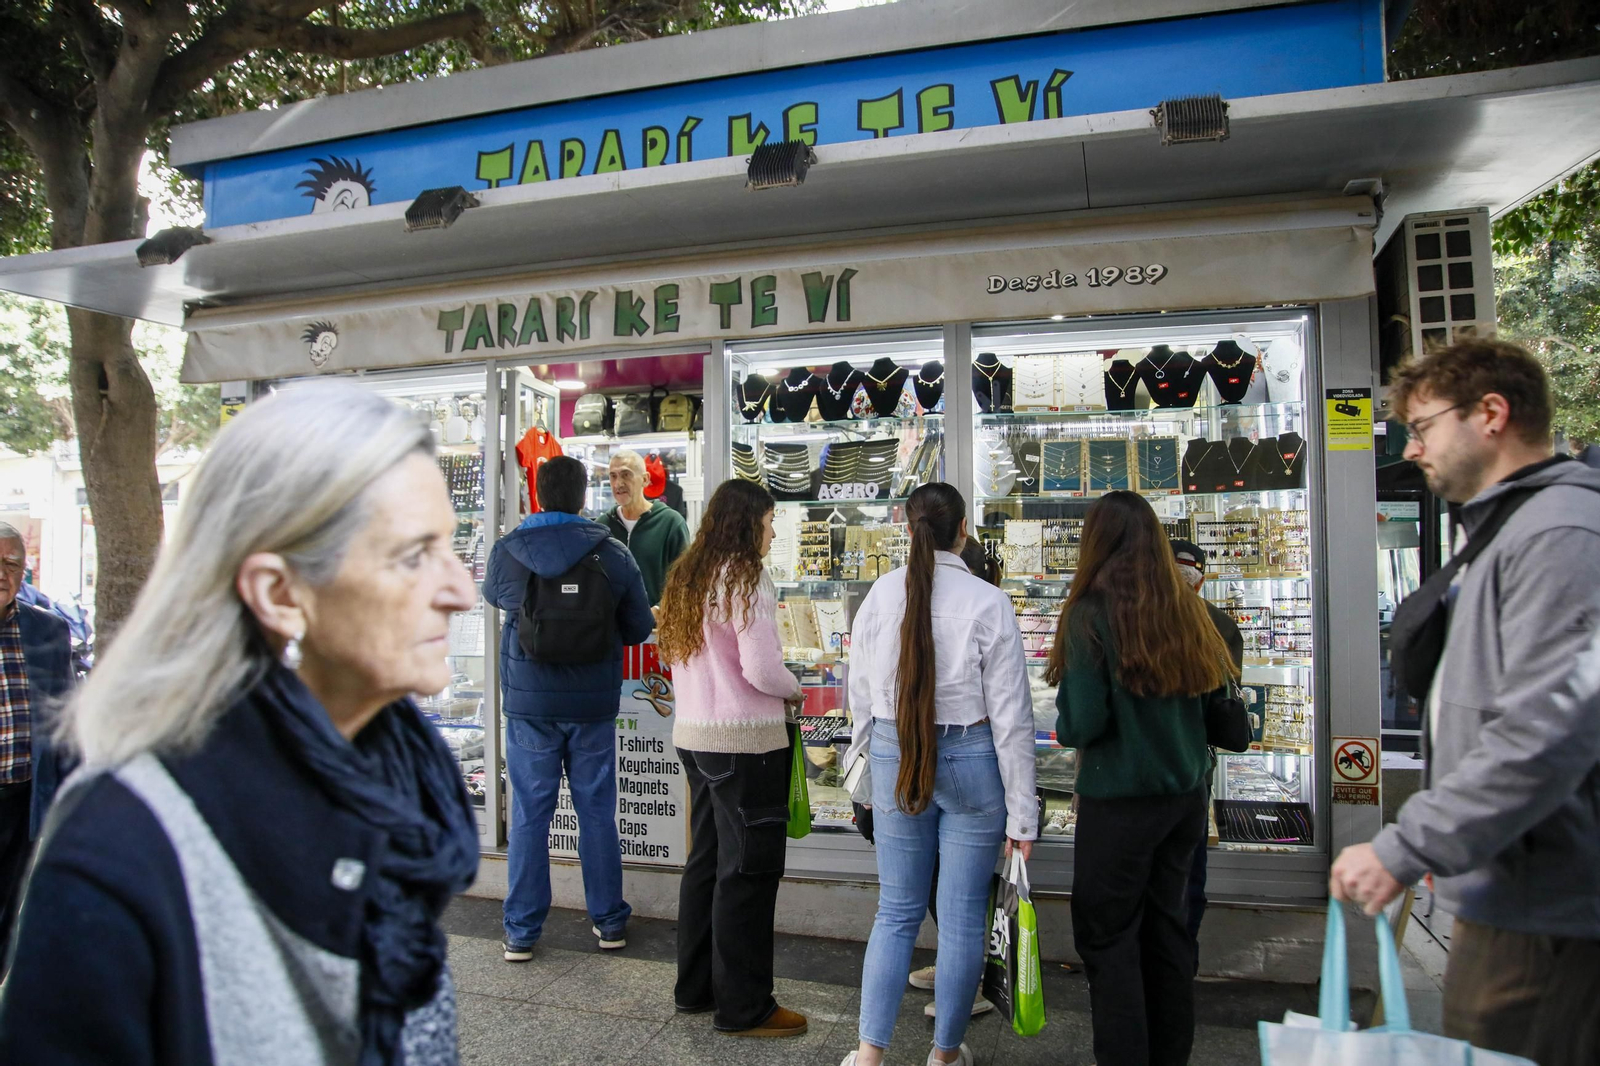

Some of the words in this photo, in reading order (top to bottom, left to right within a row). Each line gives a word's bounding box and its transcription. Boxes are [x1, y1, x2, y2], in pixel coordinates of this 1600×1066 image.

[987, 269, 1078, 294] Desde
[1085, 263, 1168, 288] 1989
[437, 290, 599, 354] TARARÍ
[613, 283, 680, 338] KE
[709, 275, 779, 330] TE
[801, 268, 860, 323] VÍ
[817, 482, 880, 500] ACERO
[618, 735, 664, 753] T-shirts
[619, 756, 680, 775] Keychains
[619, 777, 669, 796] Magnets
[619, 797, 676, 817] Bracelets
[619, 818, 648, 837] Caps
[619, 839, 669, 858] Stickers
